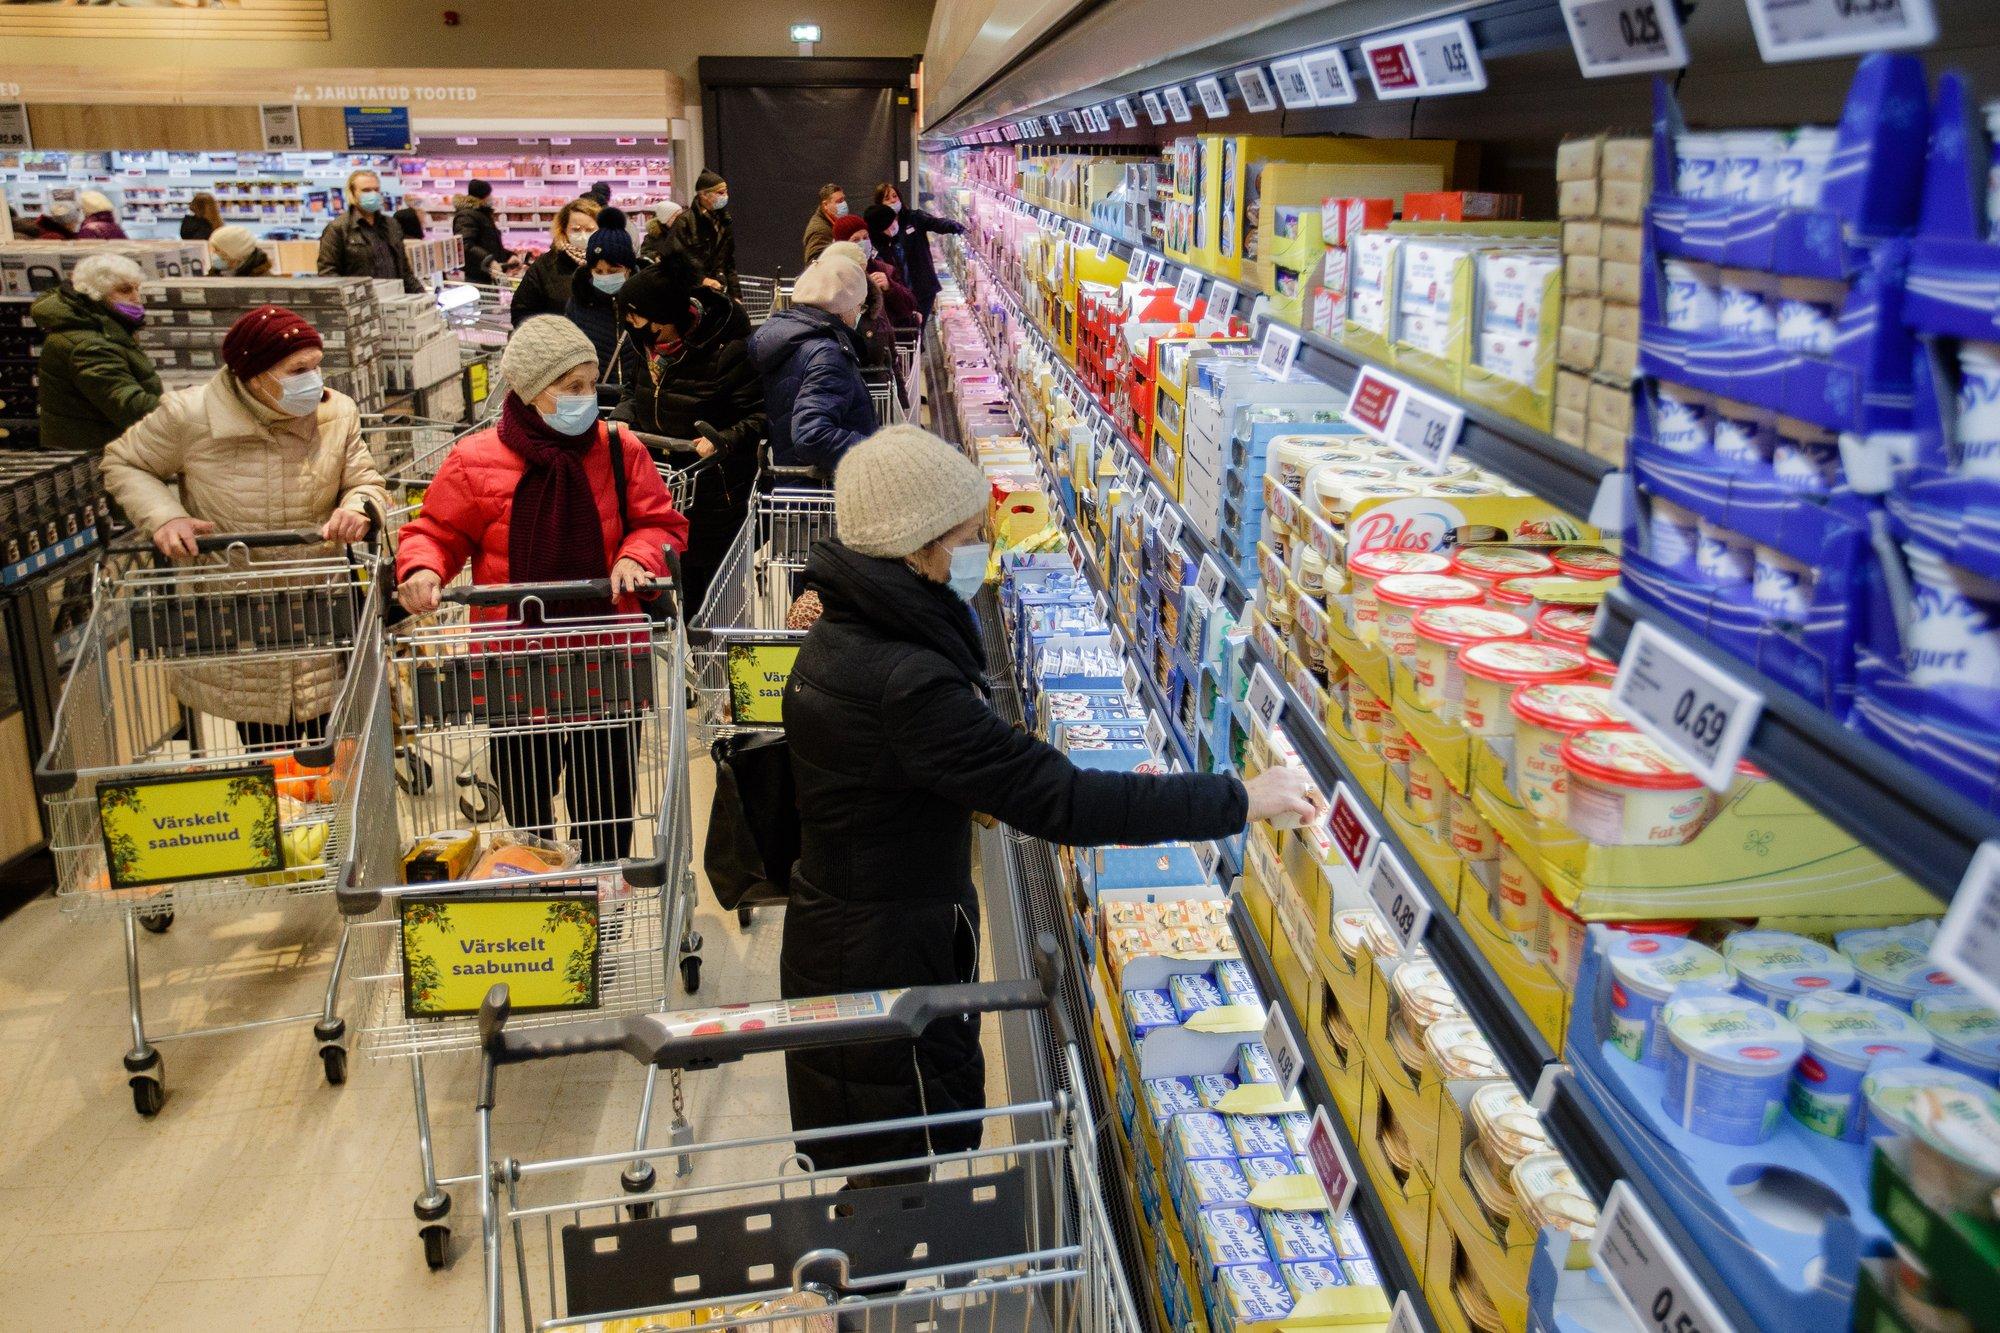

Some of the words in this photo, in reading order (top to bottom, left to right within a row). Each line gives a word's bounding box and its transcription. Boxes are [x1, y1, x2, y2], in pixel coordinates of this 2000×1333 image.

[316, 86, 410, 101] JAHUTATUD
[415, 86, 477, 101] TOOTED
[1356, 513, 1432, 551] Pilos
[1674, 689, 1726, 747] 0.69
[152, 811, 231, 830] Värskelt
[148, 828, 240, 849] saabunud
[1391, 894, 1415, 935] 0.89
[460, 937, 546, 953] Värskelt
[452, 958, 555, 976] saabunud
[1277, 1046, 1293, 1081] 0.93
